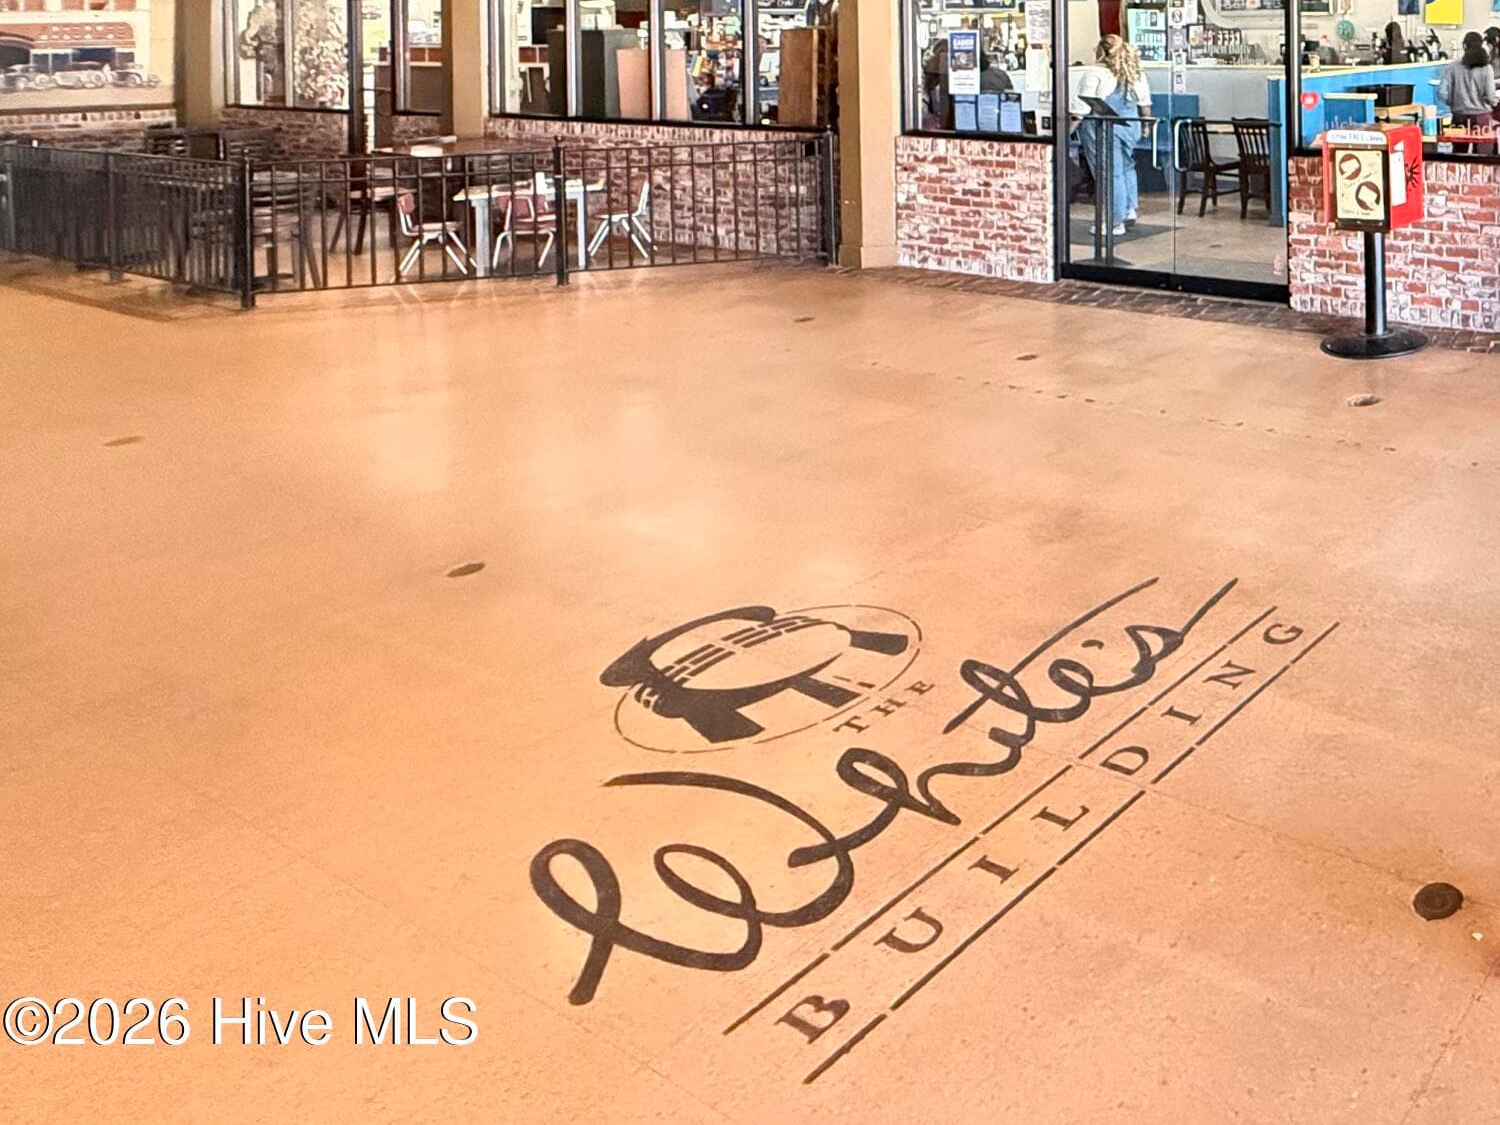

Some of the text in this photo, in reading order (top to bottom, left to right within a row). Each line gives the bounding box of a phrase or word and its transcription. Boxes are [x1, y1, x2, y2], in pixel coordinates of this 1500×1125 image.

[529, 577, 1238, 1006] White's
[775, 621, 1304, 1044] BUILDING
[836, 679, 934, 734] THE
